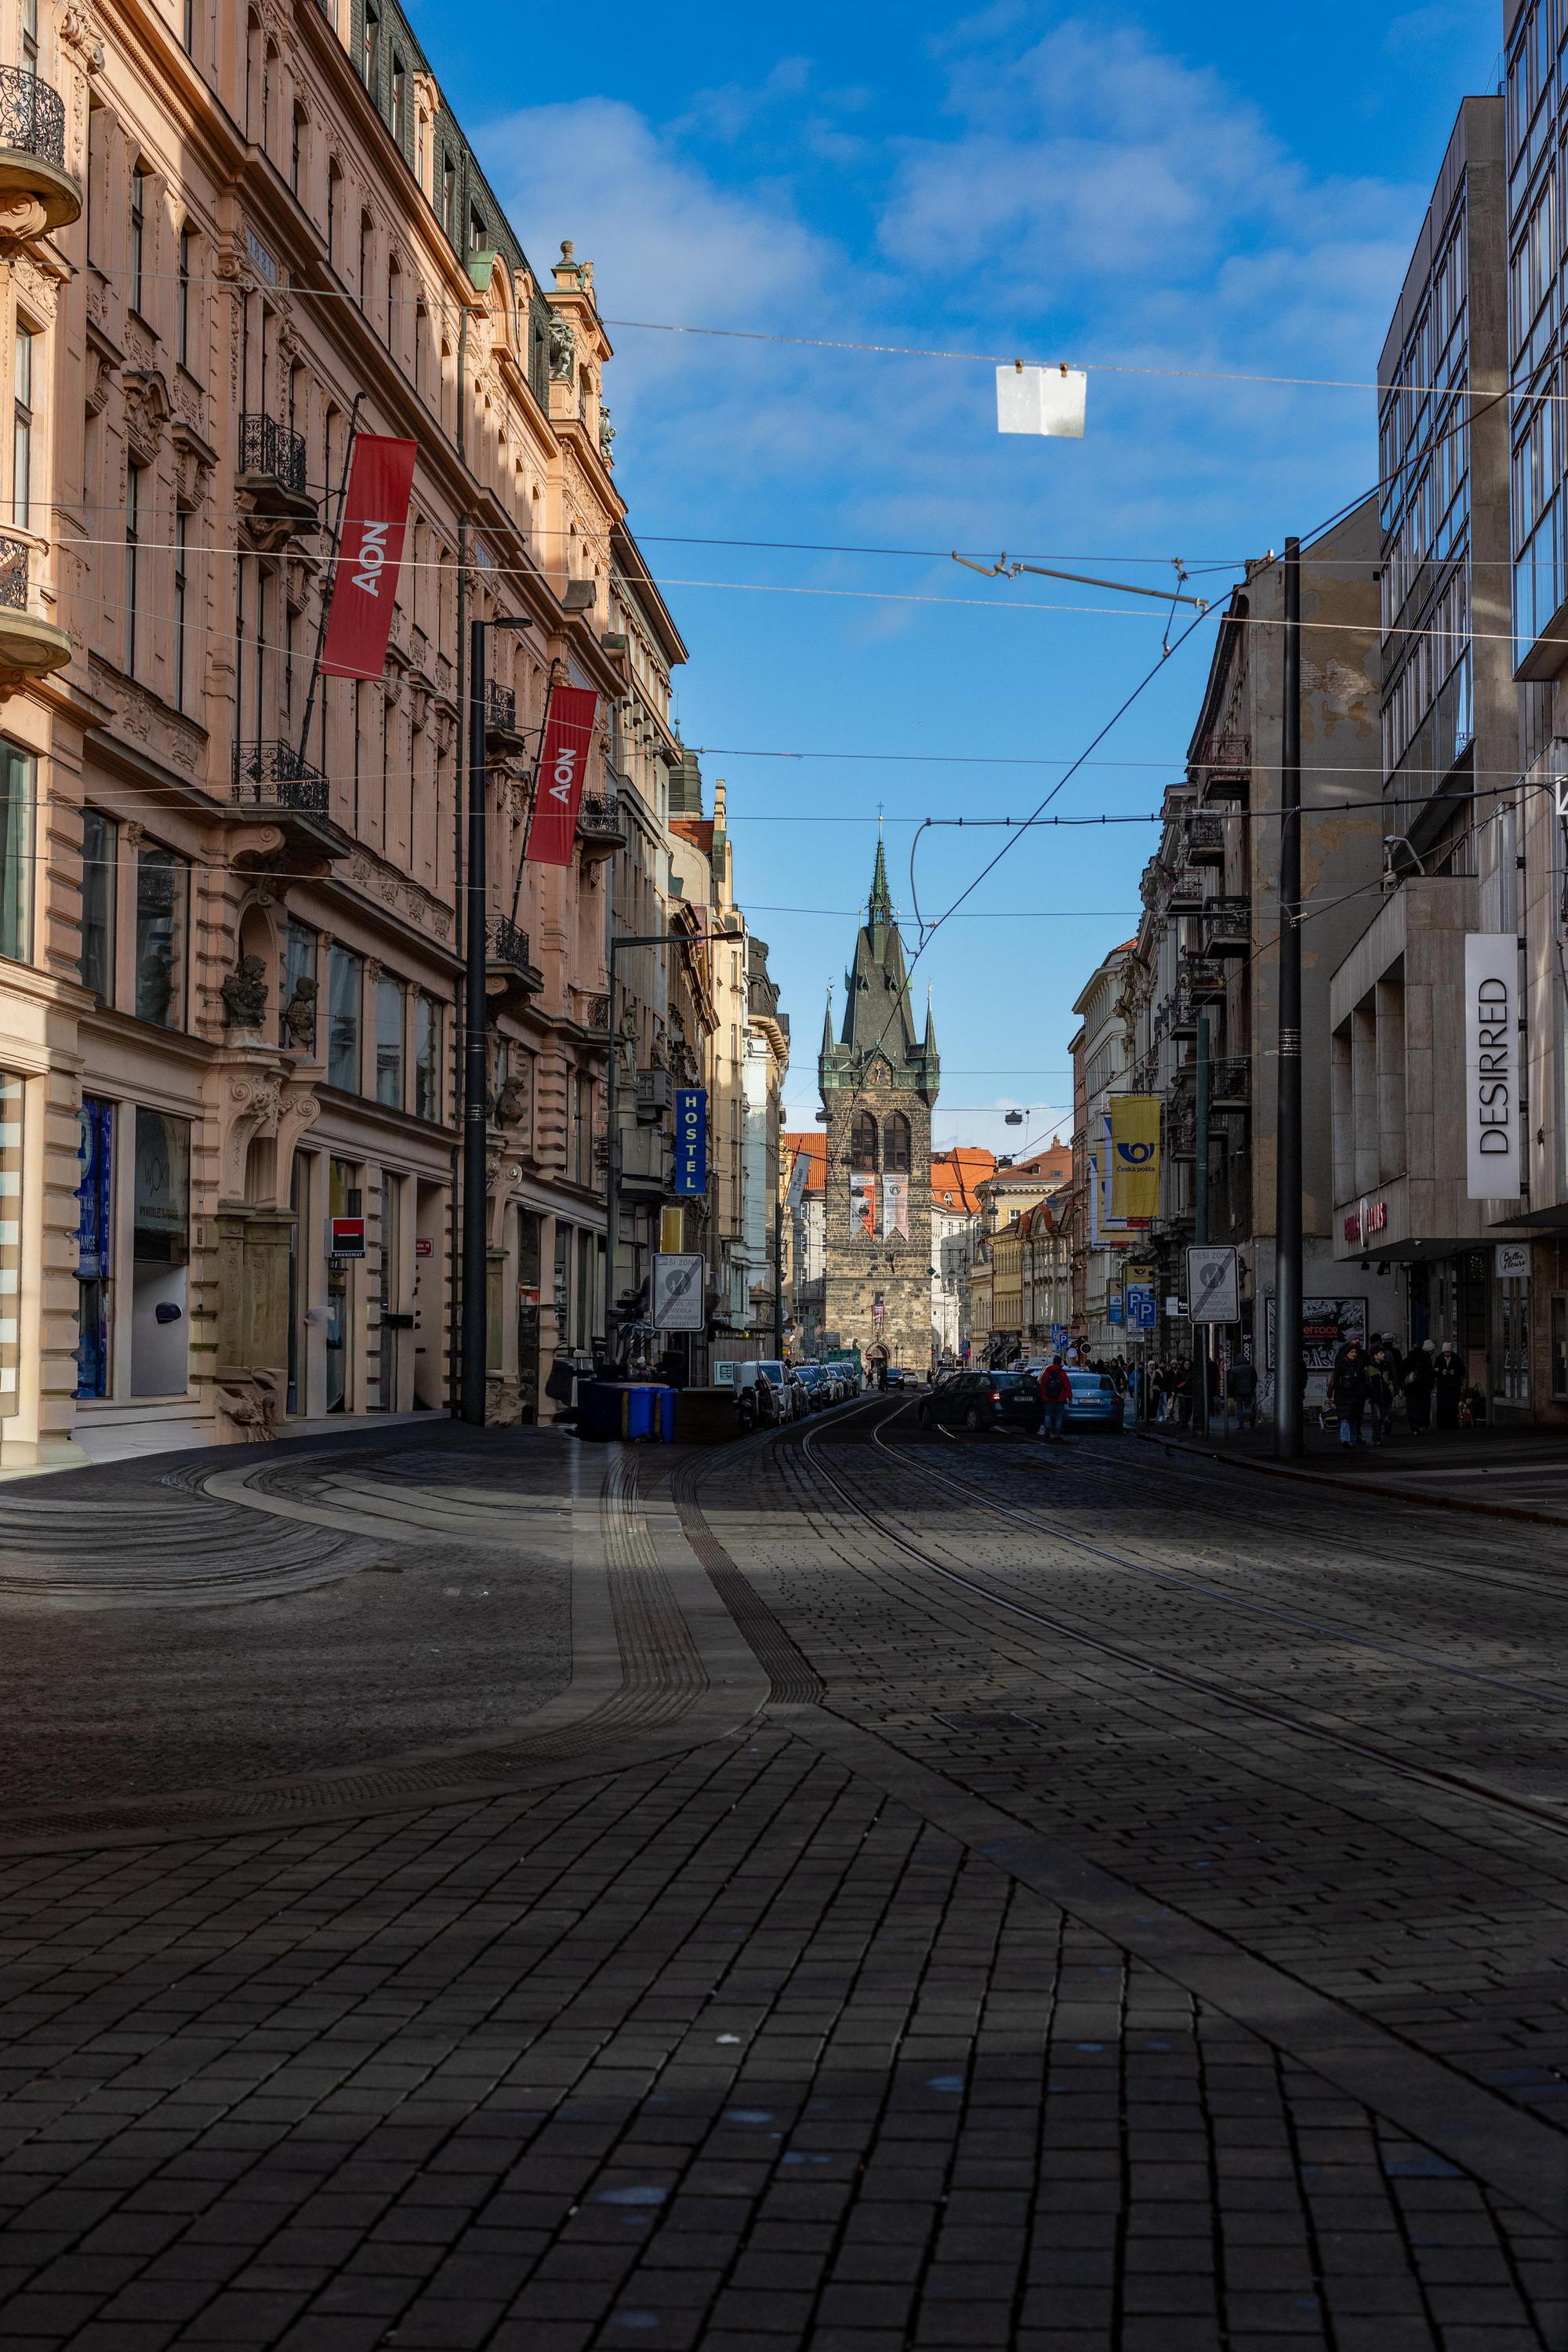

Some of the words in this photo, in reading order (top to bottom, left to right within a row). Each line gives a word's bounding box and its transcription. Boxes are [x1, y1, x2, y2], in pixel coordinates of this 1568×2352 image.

[352, 520, 389, 597] AON
[549, 747, 577, 804] AON
[1478, 978, 1508, 1155] DESIRRED
[684, 1096, 698, 1189] HOSTEL
[1142, 1303, 1152, 1319] P
